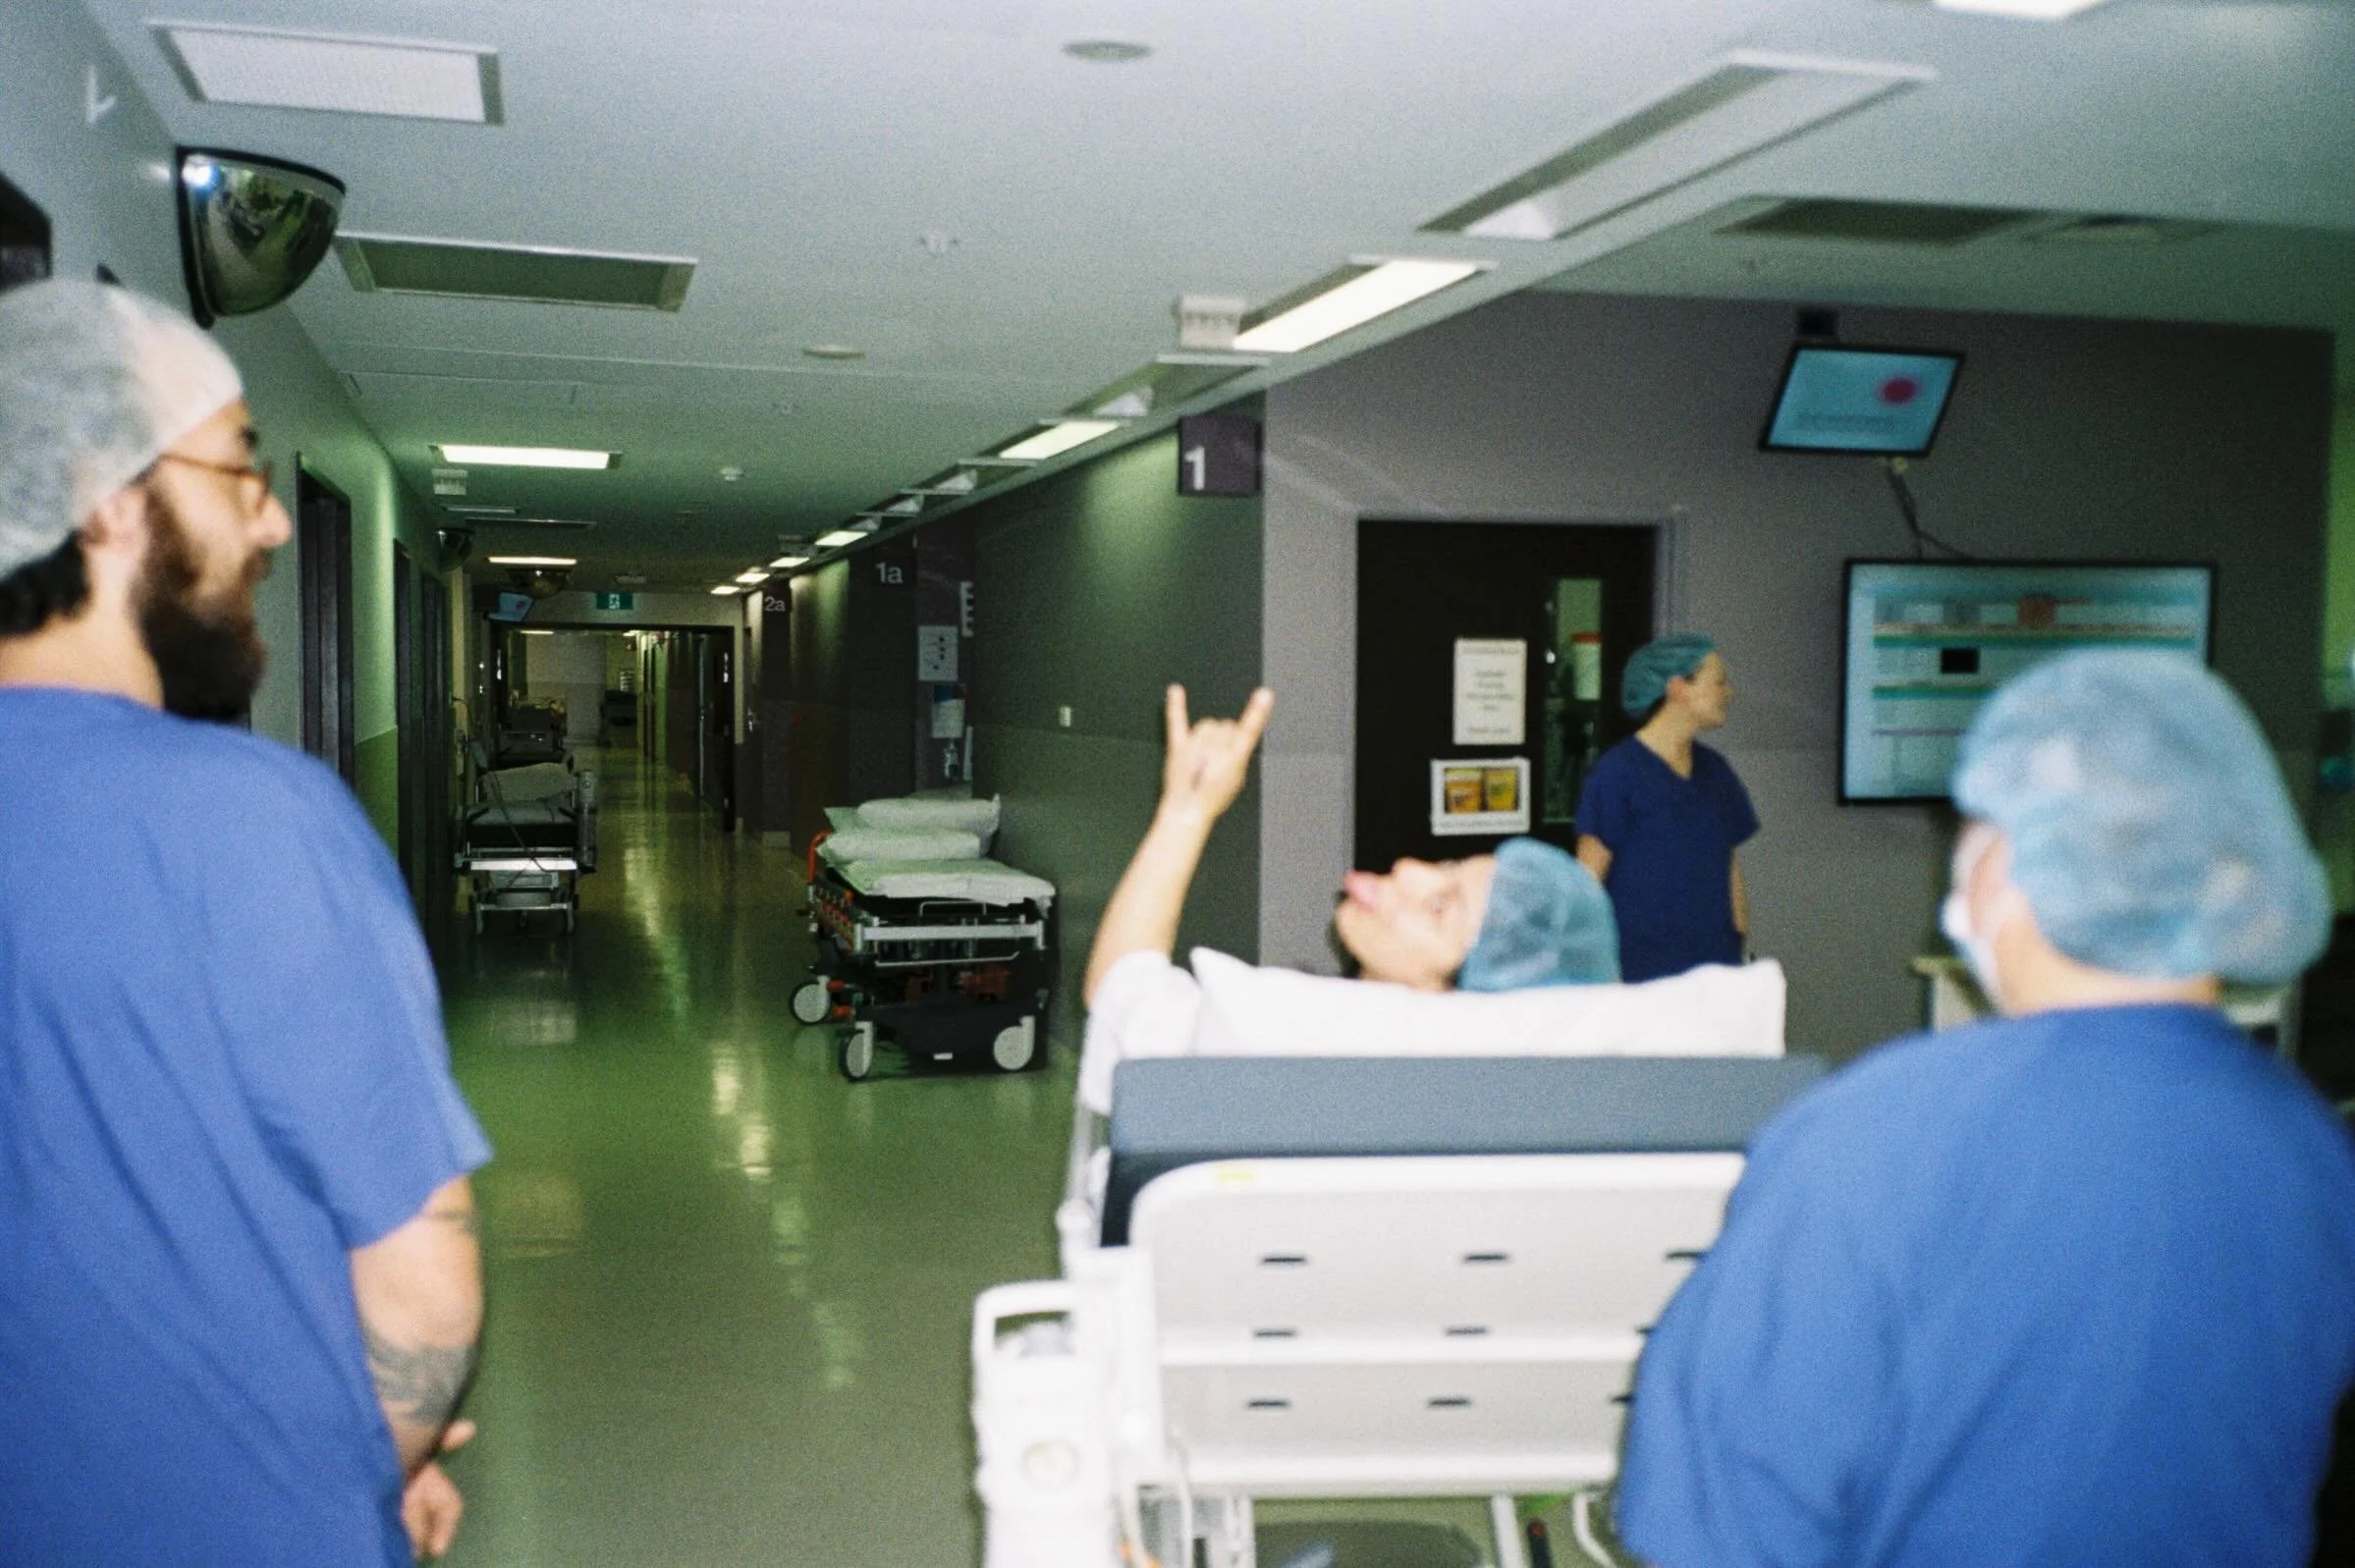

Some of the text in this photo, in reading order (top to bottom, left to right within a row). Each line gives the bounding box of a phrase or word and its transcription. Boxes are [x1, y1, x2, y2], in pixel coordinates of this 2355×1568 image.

[1184, 445, 1205, 490] 1
[875, 563, 904, 584] 1a
[765, 596, 786, 612] 2a
